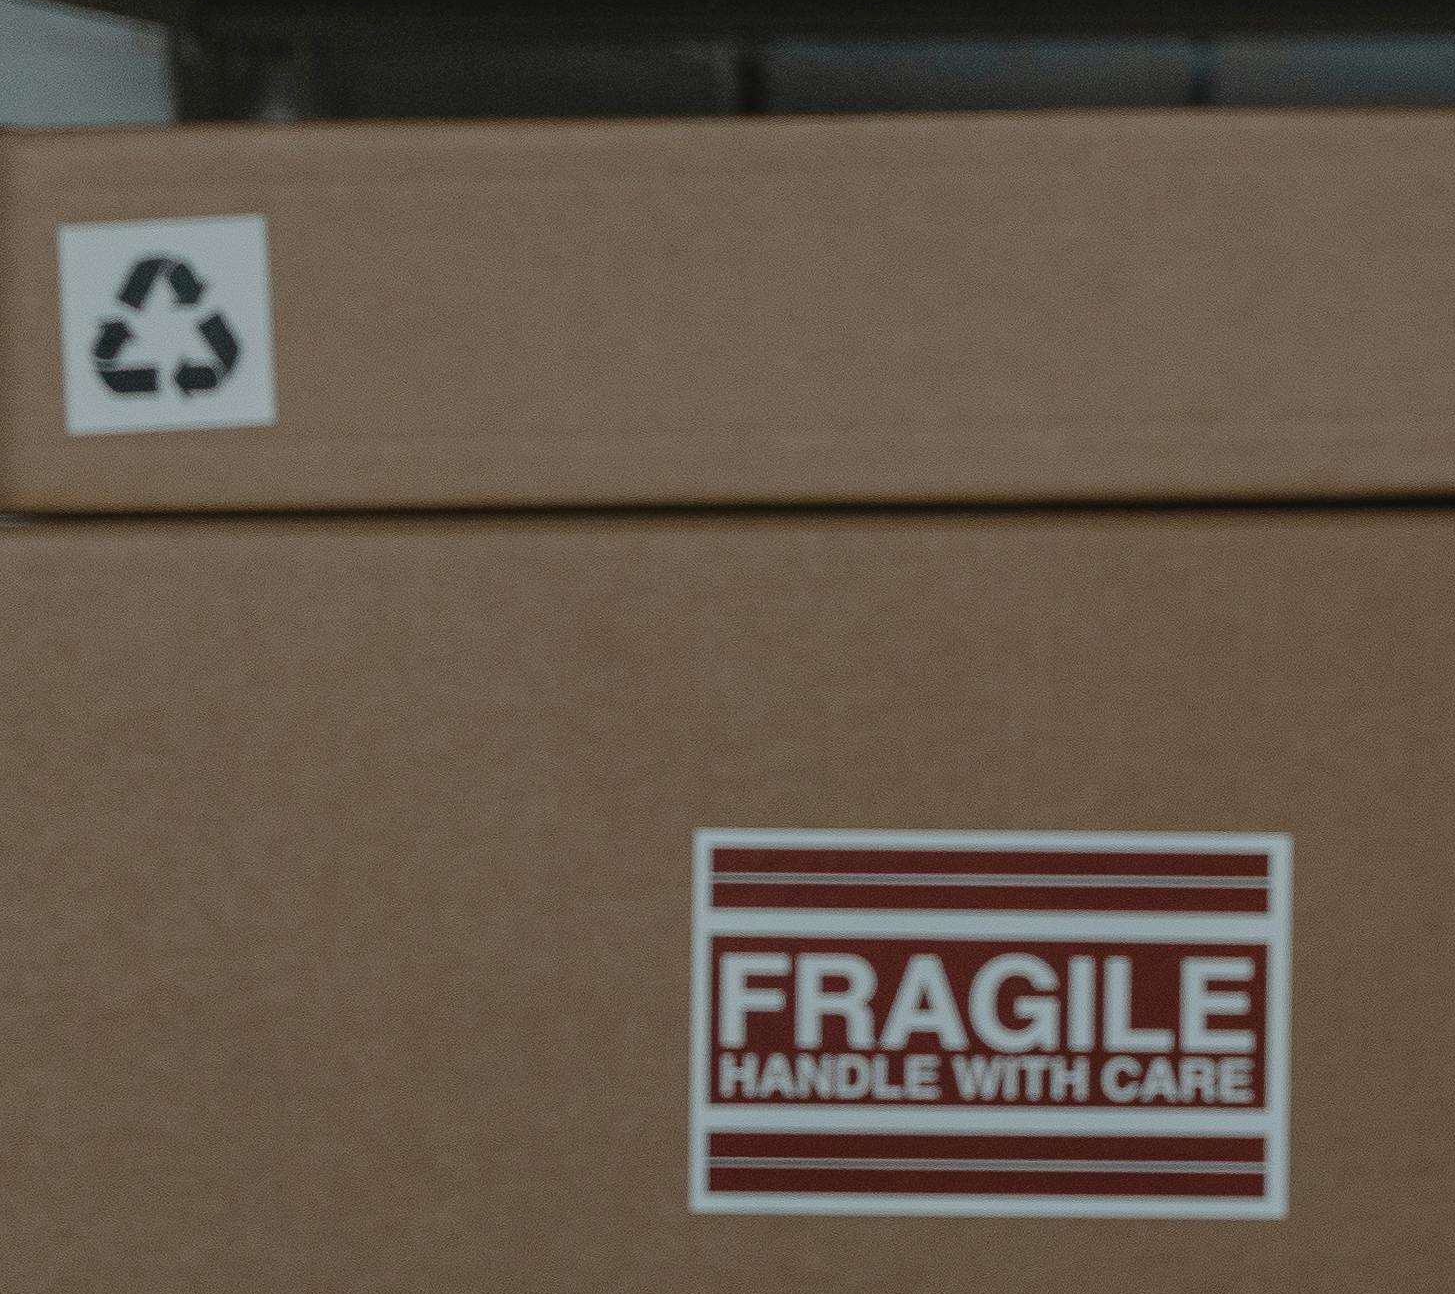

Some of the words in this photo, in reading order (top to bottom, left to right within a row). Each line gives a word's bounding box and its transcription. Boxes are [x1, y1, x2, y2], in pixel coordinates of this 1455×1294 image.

[717, 951, 1256, 1054] FRAGILE
[718, 1051, 941, 1100] HANDLE
[953, 1054, 1091, 1102] WITH
[1100, 1055, 1256, 1104] CARE
